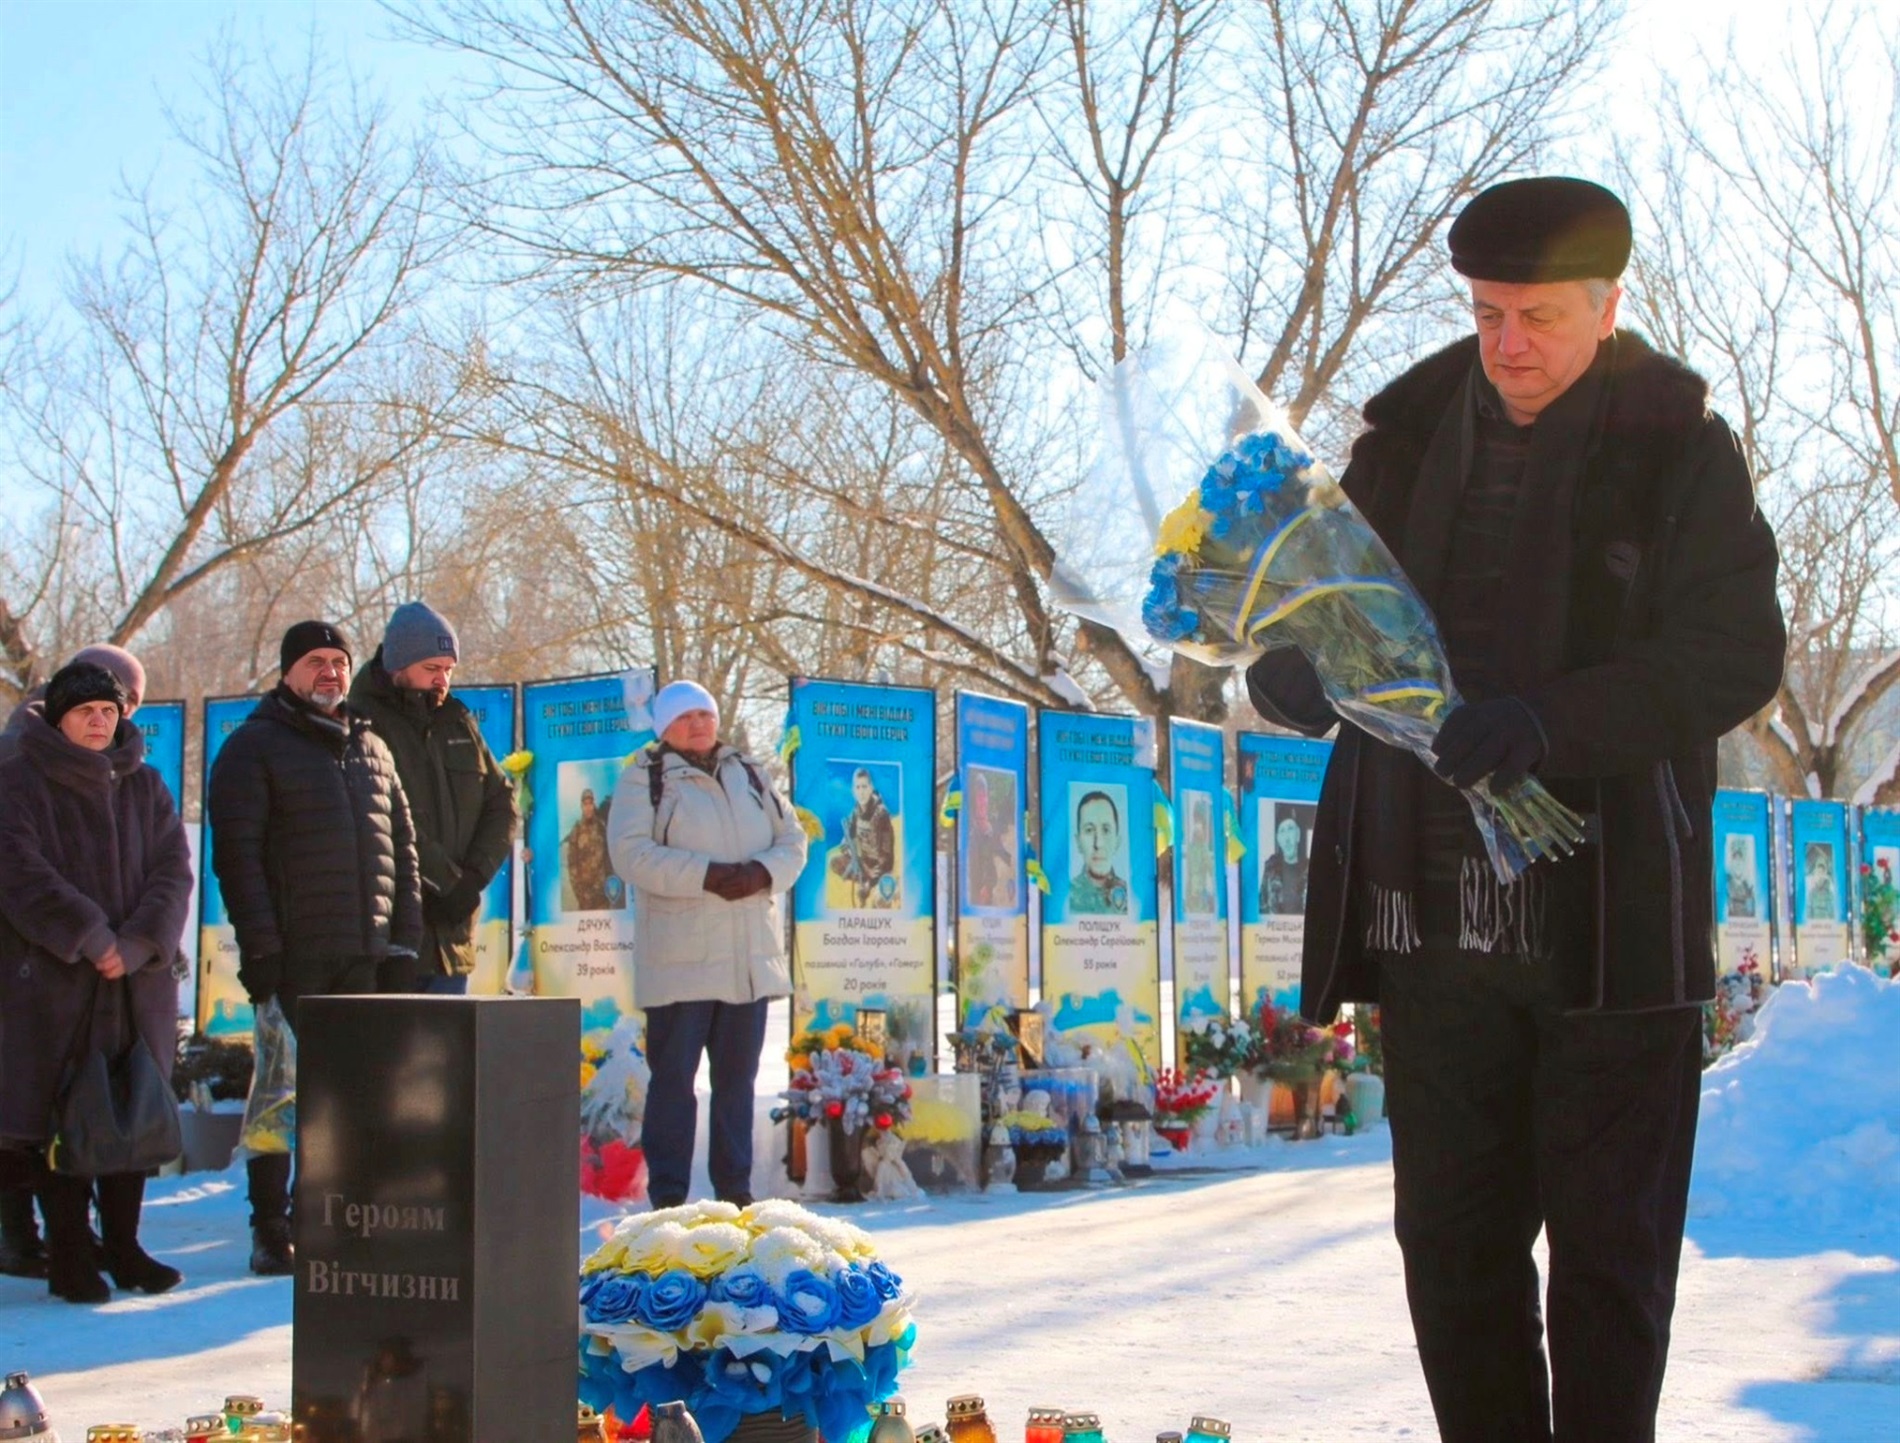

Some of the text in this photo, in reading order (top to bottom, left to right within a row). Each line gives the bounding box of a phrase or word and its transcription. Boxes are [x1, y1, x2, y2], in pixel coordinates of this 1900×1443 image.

[577, 918, 612, 933] ДЯЧУК
[838, 917, 893, 929] ПАРАЩУК
[1078, 920, 1121, 932] ПОЛІЩУК
[823, 933, 860, 946] Богдан
[540, 940, 592, 956] Олександр
[576, 963, 616, 979] 39 років
[843, 977, 887, 993] 20 років
[321, 1193, 446, 1238] Героям
[306, 1258, 461, 1302] Вітчизни
